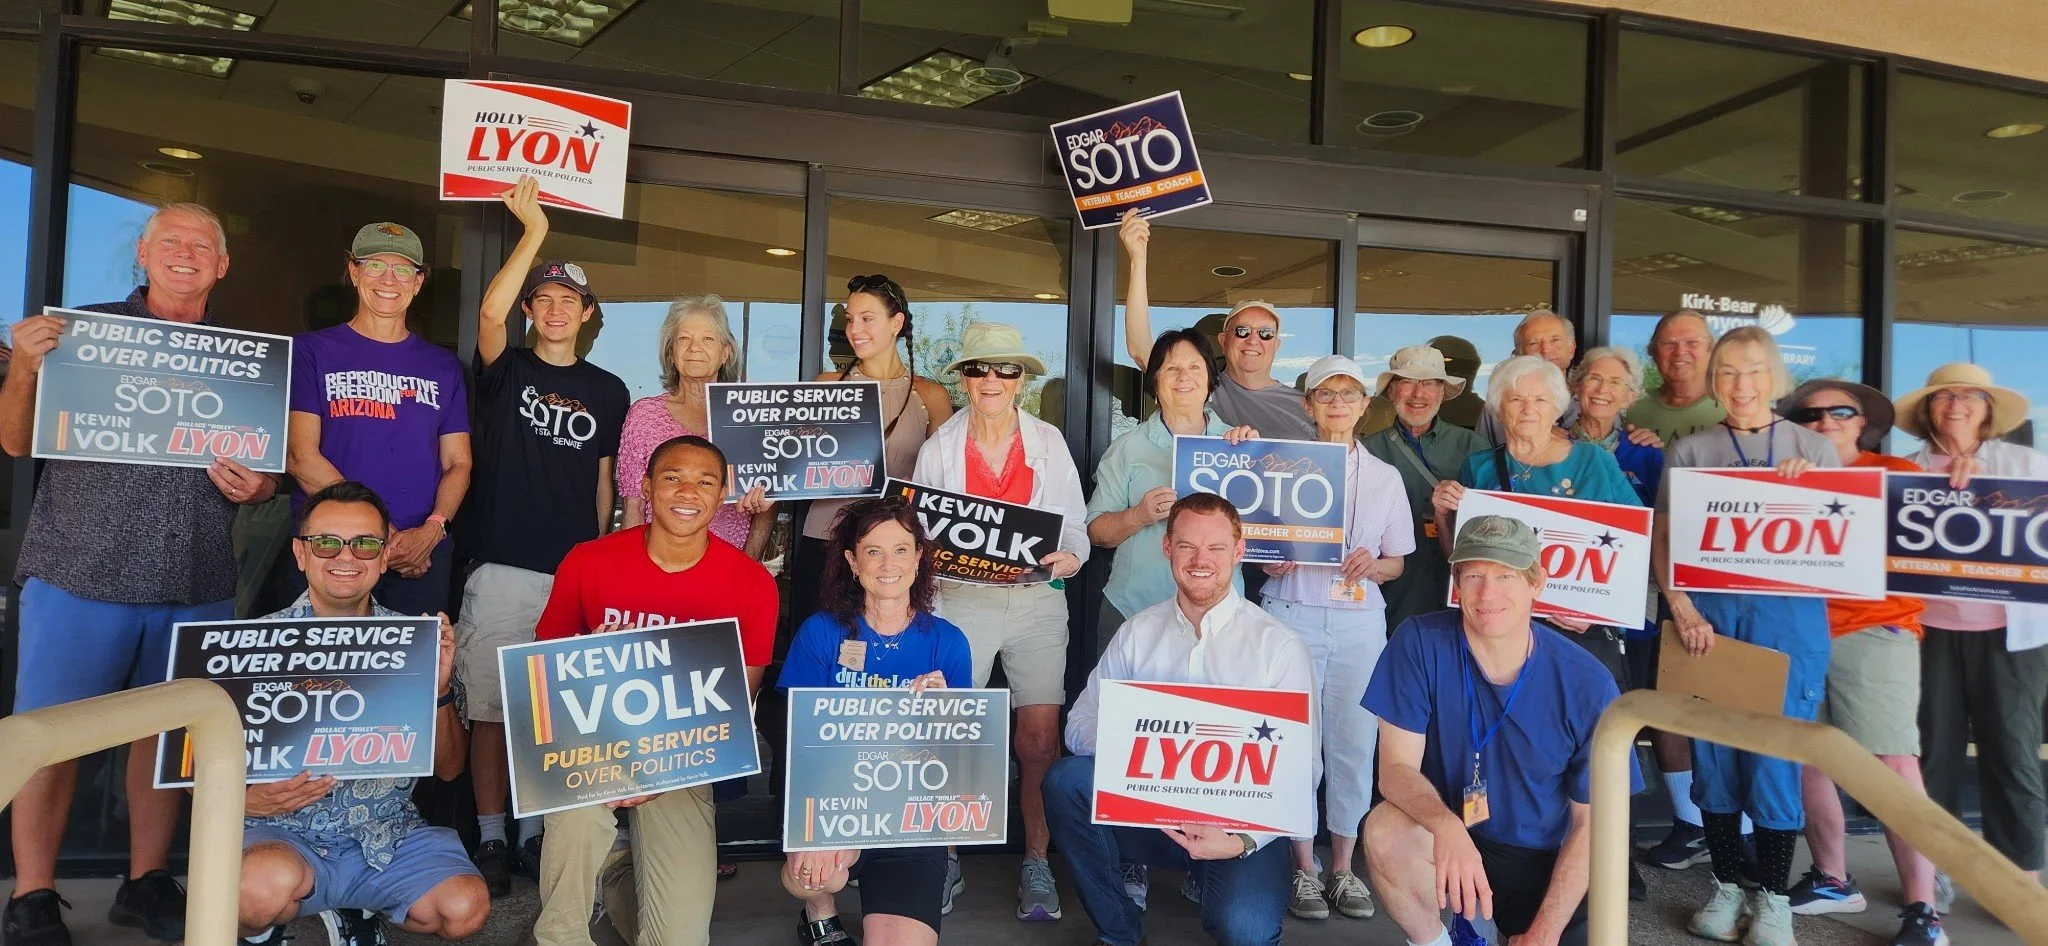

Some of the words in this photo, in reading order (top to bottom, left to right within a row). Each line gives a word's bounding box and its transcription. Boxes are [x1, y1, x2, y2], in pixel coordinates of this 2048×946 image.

[475, 111, 527, 125] HOLLY
[466, 126, 600, 174] LYON
[1066, 128, 1105, 151] EDGAR
[1070, 128, 1182, 189] SOTO
[497, 165, 529, 173] SERVICE
[531, 168, 554, 178] OVER
[554, 172, 593, 185] POLITICS
[1082, 194, 1112, 207] VETERAN
[1115, 186, 1153, 202] TEACHER
[1157, 175, 1194, 192] COACH
[1682, 293, 1757, 314] Kirk-Bear
[1706, 315, 1756, 334] nyon
[71, 320, 162, 346] PUBLIC
[168, 333, 269, 359] SERVICE
[77, 344, 147, 367] OVER
[152, 351, 261, 379] POLITICS
[1783, 352, 1816, 365] BRARY
[120, 374, 157, 386] EDGAR
[325, 371, 440, 395] REPRODUCTIVE
[114, 384, 223, 419] SOTO
[326, 384, 401, 404] FREEDOM
[401, 390, 416, 398] FOR
[416, 391, 441, 410] ALL
[726, 389, 790, 405] PUBLIC
[793, 388, 864, 403] SERVICE
[75, 412, 131, 428] KEVIN
[329, 398, 396, 419] ARIZONA
[519, 389, 597, 442] SOTO
[732, 407, 782, 423] OVER
[785, 406, 861, 422] POLITICS
[73, 428, 158, 455] VOLK
[166, 426, 271, 460] LYON
[552, 436, 583, 450] SENATE
[764, 428, 790, 436] EDGAR
[762, 434, 839, 460] SOTO
[738, 463, 777, 474] KEVIN
[1193, 451, 1251, 469] EDGAR
[738, 474, 799, 494] VOLK
[803, 464, 874, 489] LYON
[918, 492, 1005, 525] KEVIN
[1706, 501, 1764, 513] HOLLY
[1903, 488, 1975, 507] EDGAR
[917, 512, 1043, 566] VOLK
[1242, 526, 1289, 537] TEACHER
[1295, 529, 1334, 539] COACH
[1699, 517, 1850, 555] LYON
[948, 565, 1017, 580] POLITICS
[957, 554, 1035, 574] SERVICE
[1540, 544, 1619, 584] ON
[1700, 556, 1733, 564] PUBLIC
[1734, 557, 1773, 565] SERVICE
[1774, 558, 1798, 567] OVER
[1799, 559, 1845, 567] POLITICS
[1891, 559, 1950, 572] VETERAN
[1960, 563, 2023, 578] TEACHER
[1546, 583, 1569, 591] OVER
[1570, 585, 1610, 595] POLITICS
[201, 628, 300, 650] PUBLIC
[304, 626, 415, 647] SERVICE
[206, 654, 281, 675] OVER
[287, 651, 406, 672] POLITICS
[555, 638, 672, 682] KEVIN
[252, 681, 292, 692] EDGAR
[245, 689, 365, 724] SOTO
[559, 667, 732, 735] VOLK
[813, 698, 893, 716] PUBLIC
[897, 697, 989, 716] SERVICE
[819, 722, 878, 741] OVER
[884, 722, 982, 740] POLITICS
[1135, 718, 1194, 734] HOLLY
[247, 746, 294, 771] LK
[302, 731, 417, 767] LYON
[543, 740, 631, 772] PUBLIC
[637, 722, 730, 755] SERVICE
[857, 751, 889, 761] EDGAR
[566, 765, 622, 789] OVER
[630, 748, 716, 778] POLITICS
[1125, 736, 1279, 785] LYON
[853, 760, 949, 792] SOTO
[1126, 783, 1160, 793] PUBLIC
[1162, 785, 1200, 795] SERVICE
[1202, 788, 1227, 797] OVER
[1229, 790, 1273, 799] POLITICS
[819, 797, 868, 811] KEVIN
[818, 813, 893, 838] VOLK
[899, 800, 992, 833] LYON
